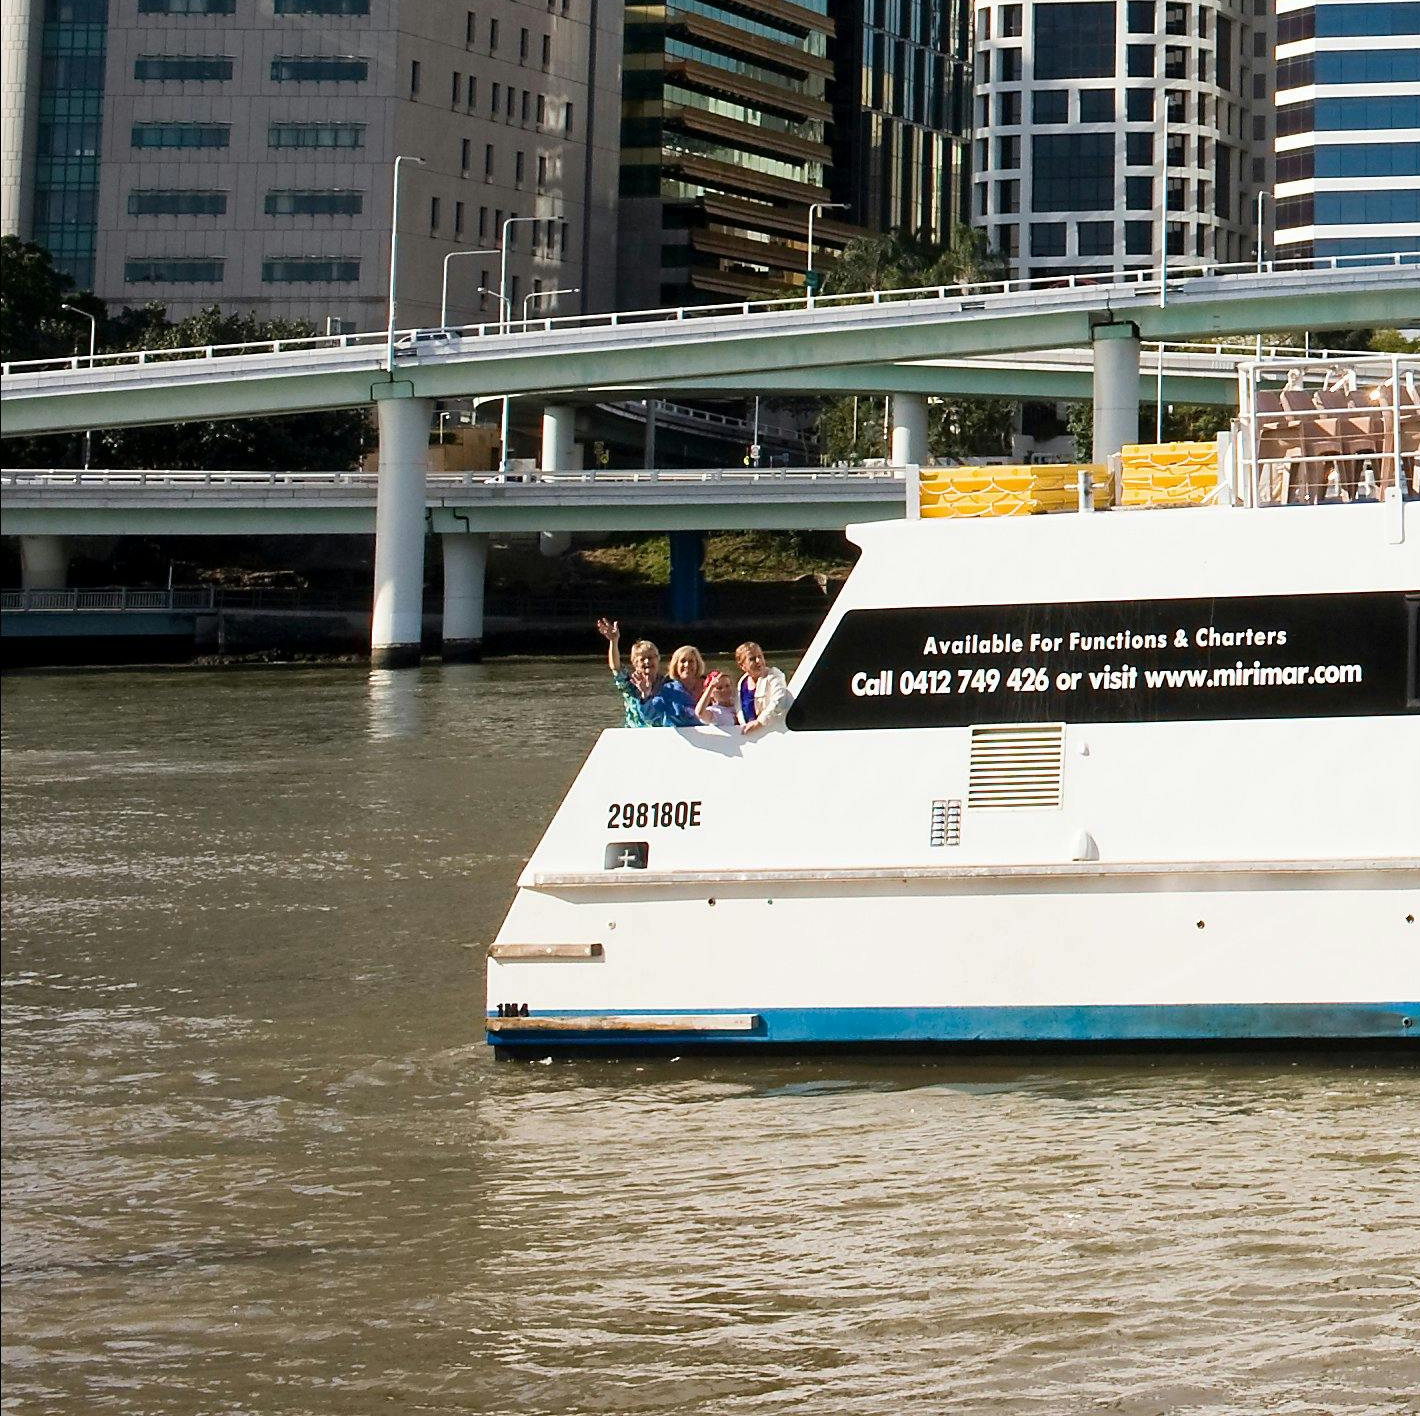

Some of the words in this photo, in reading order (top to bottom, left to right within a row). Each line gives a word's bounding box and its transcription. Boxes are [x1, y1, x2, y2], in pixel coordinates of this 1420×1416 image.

[923, 633, 1024, 655] Available
[1029, 633, 1064, 653] For
[1069, 629, 1168, 651] Functions
[1173, 628, 1189, 648] &
[1195, 626, 1287, 647] Charters
[851, 670, 894, 696] Call
[899, 670, 951, 695] 0412
[957, 668, 1001, 694] 749
[1006, 666, 1050, 692] 426
[1055, 670, 1083, 691] or
[1088, 664, 1138, 690] visit
[1143, 660, 1363, 689] www.mirimar.com
[607, 801, 702, 830] 29818QE
